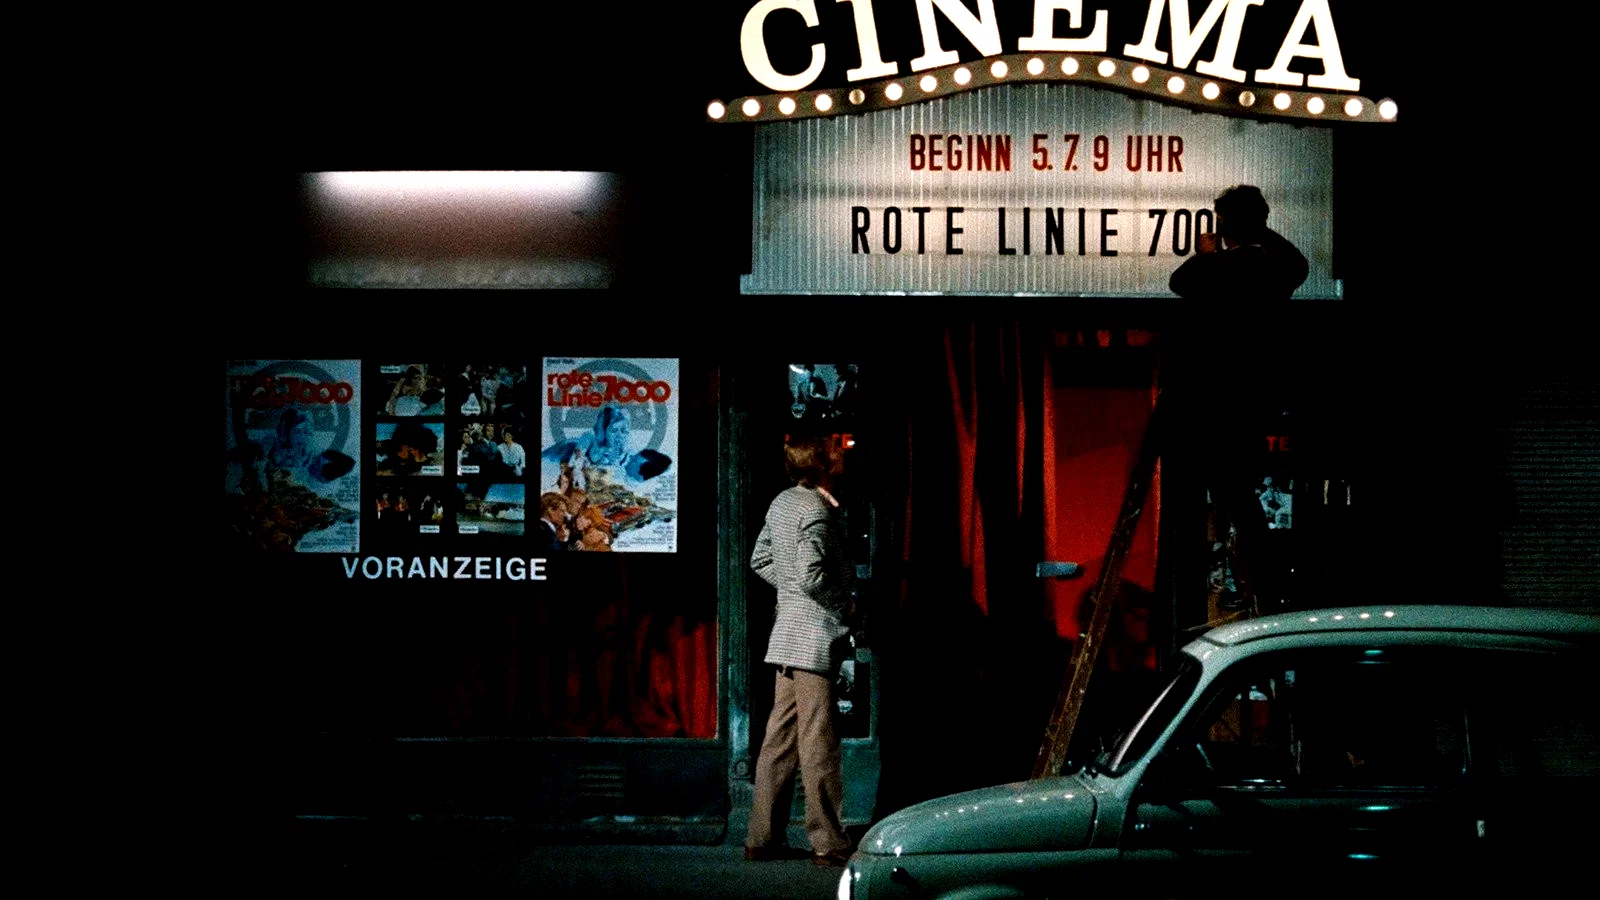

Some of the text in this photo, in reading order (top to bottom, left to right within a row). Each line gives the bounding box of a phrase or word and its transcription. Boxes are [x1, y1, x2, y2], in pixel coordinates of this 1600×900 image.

[740, 0, 1361, 94] CINEMA
[910, 133, 1011, 172] BEGINN
[1093, 134, 1109, 172] 9
[1126, 135, 1184, 173] UHR
[851, 206, 964, 255] ROTE
[998, 206, 1118, 257] LINIE
[547, 369, 592, 390] rote
[596, 375, 671, 403] 7000
[341, 556, 548, 581] VORANZEIGE
